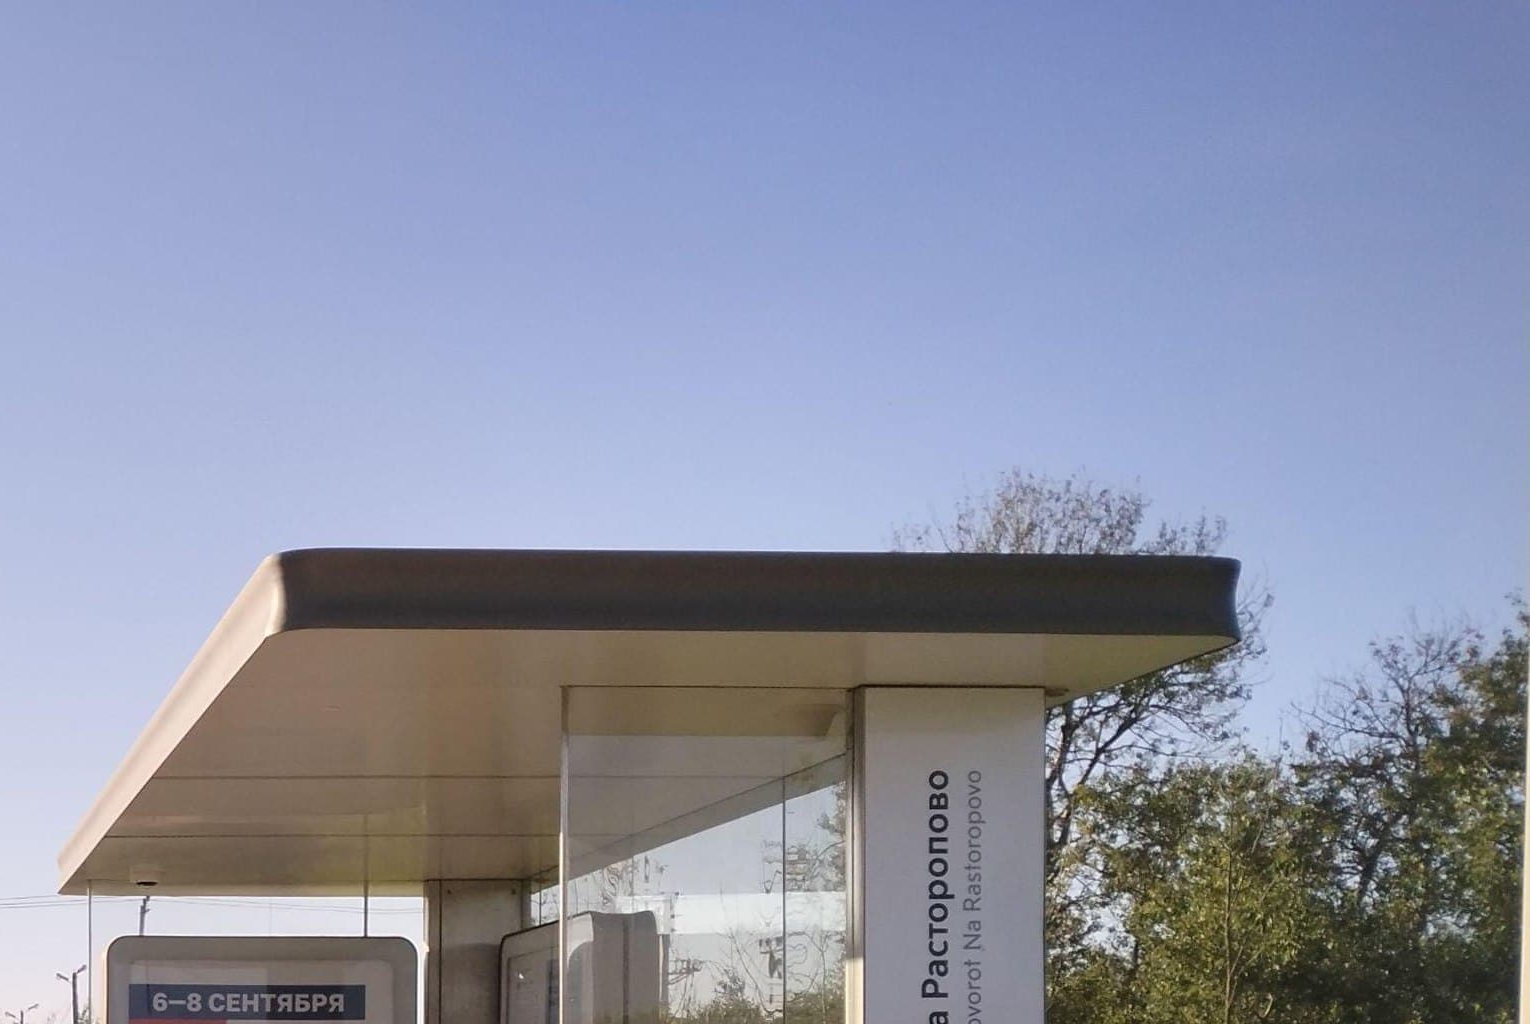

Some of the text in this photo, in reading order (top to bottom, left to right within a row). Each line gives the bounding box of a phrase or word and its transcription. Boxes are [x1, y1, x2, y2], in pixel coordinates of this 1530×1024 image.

[963, 770, 987, 912] Rastoropovo
[921, 770, 956, 1000] Расторопово
[963, 921, 983, 952] Na
[208, 993, 345, 1013] СЕНТЯБРЯ
